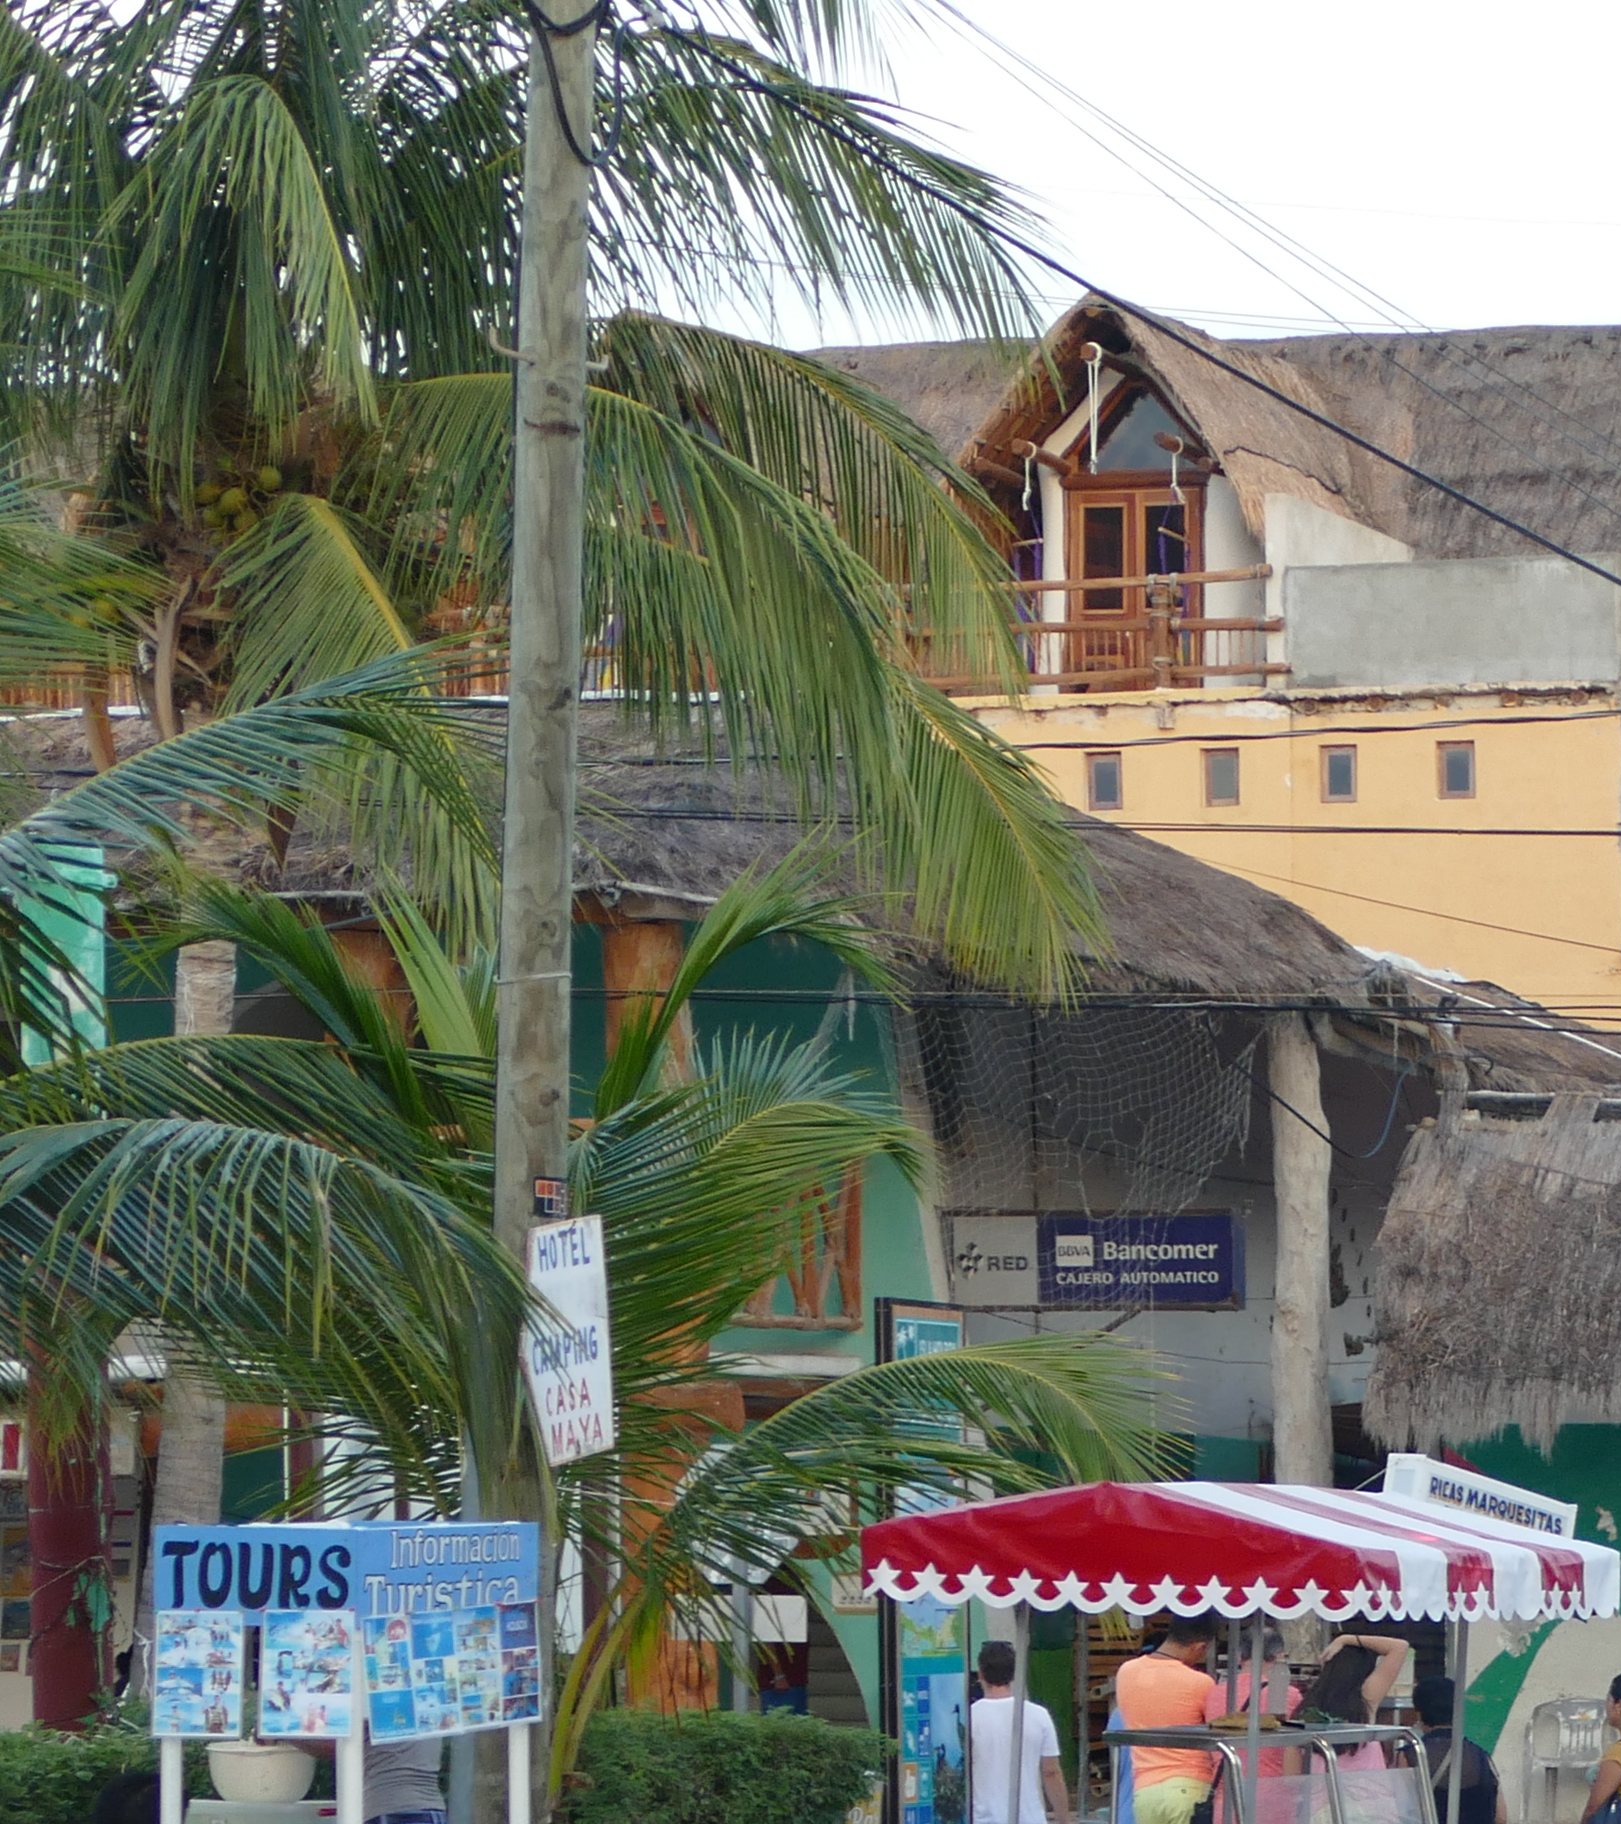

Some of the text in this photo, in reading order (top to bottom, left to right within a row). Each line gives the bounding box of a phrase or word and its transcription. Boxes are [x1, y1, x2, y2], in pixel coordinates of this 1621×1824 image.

[537, 1226, 590, 1273] HOTEL
[987, 1255, 1029, 1271] RED
[1057, 1241, 1219, 1261] BBVA Bancomer
[1056, 1271, 1220, 1286] CAJERO AUTOMATICO
[532, 1325, 598, 1375] CAMPING
[546, 1377, 591, 1417] CASA
[551, 1412, 604, 1457] MAYA
[1429, 1476, 1563, 1536] RICAS MARQUESITAS
[390, 1527, 520, 1569] Información
[162, 1540, 351, 1610] TOURS
